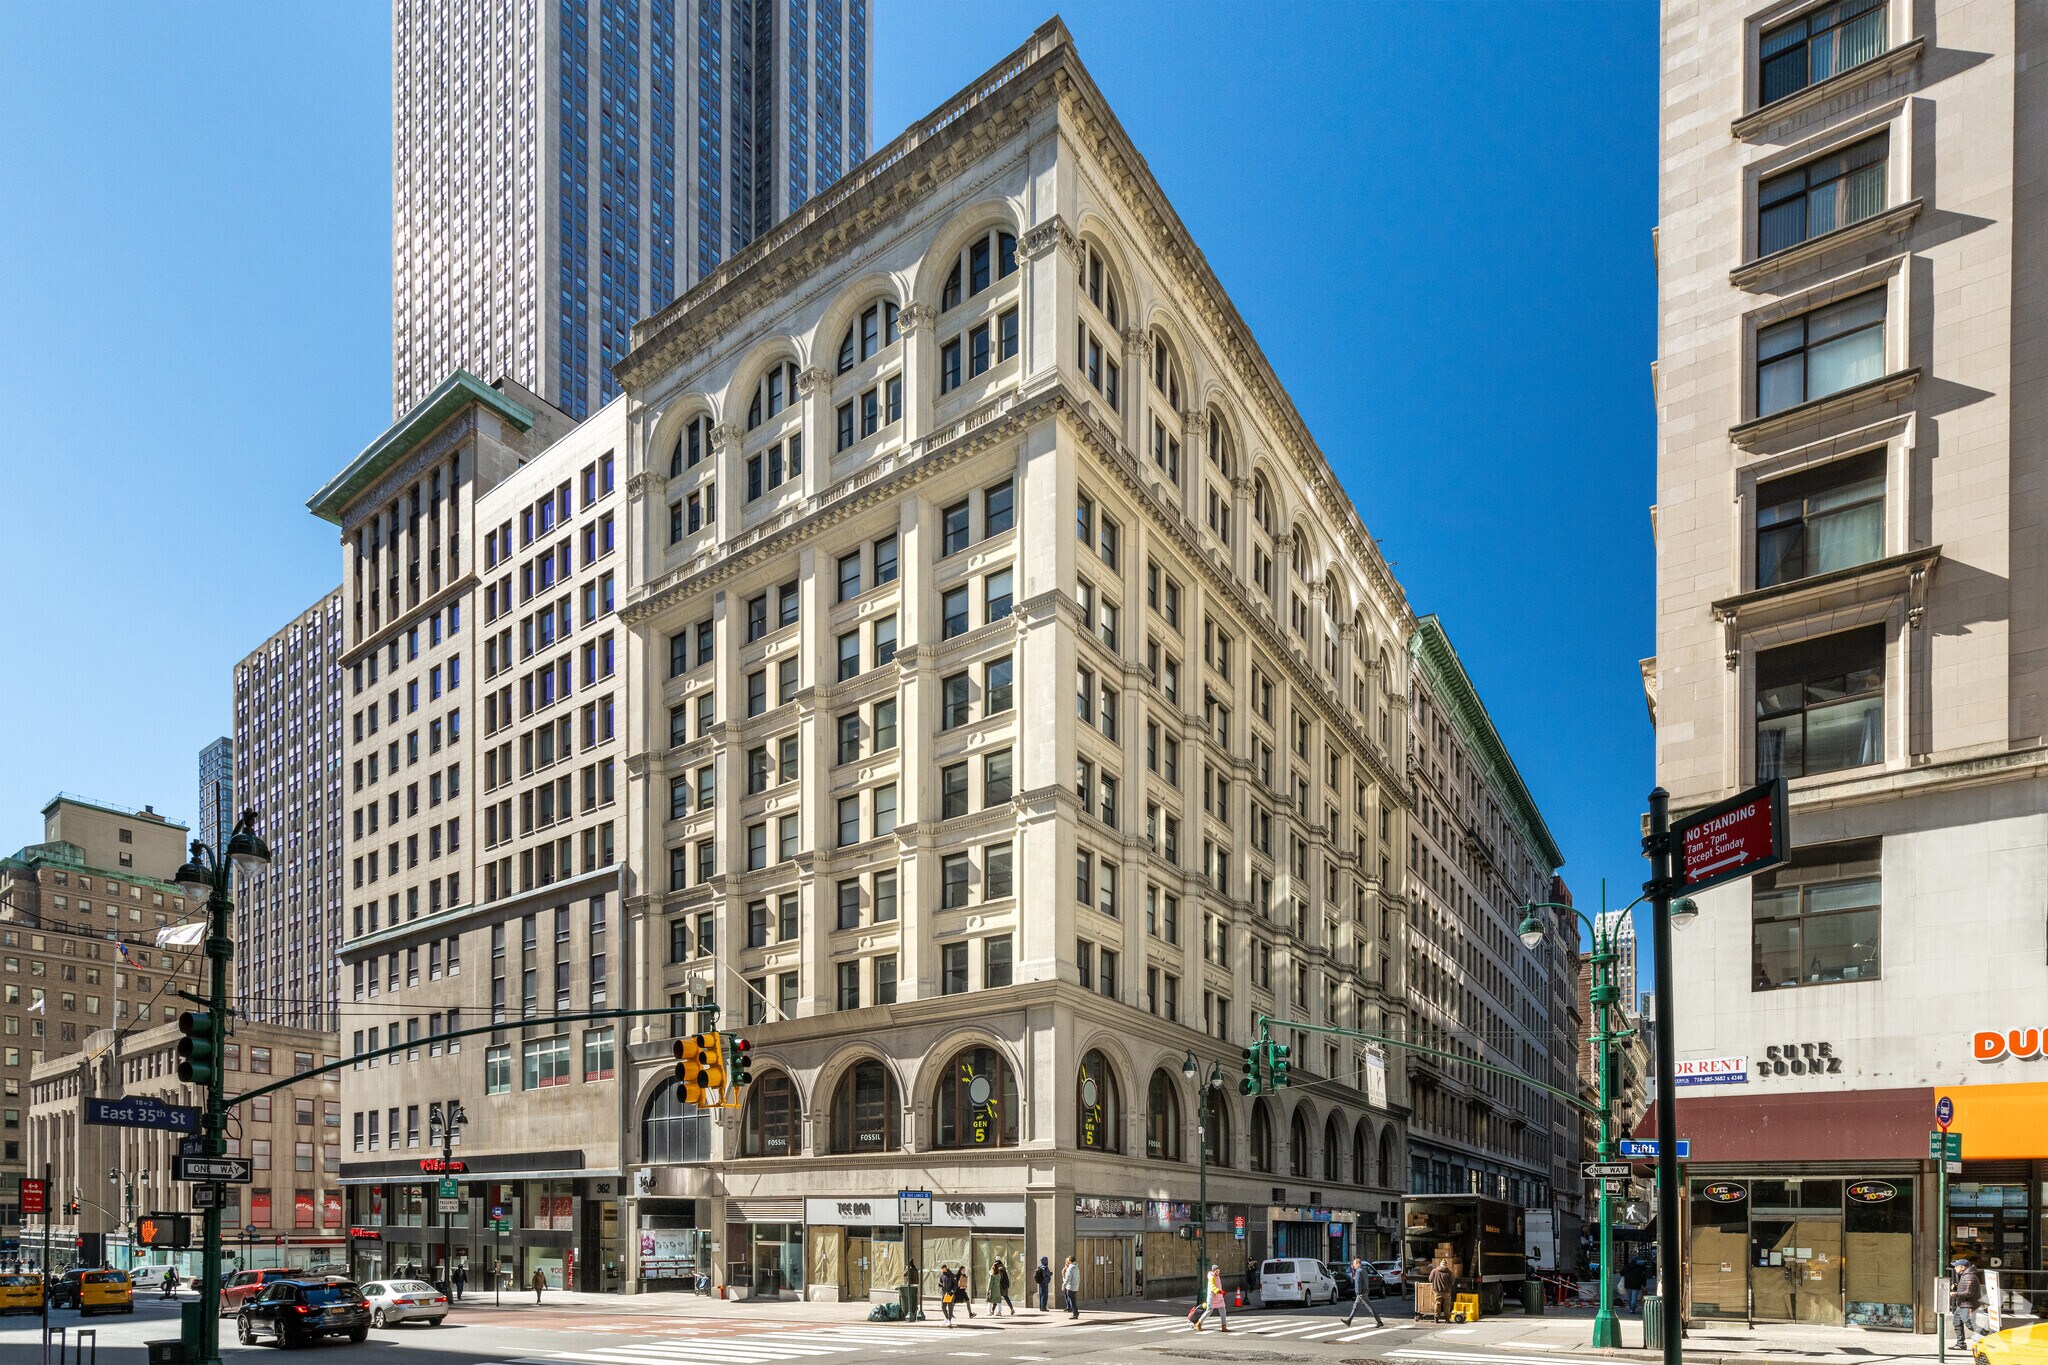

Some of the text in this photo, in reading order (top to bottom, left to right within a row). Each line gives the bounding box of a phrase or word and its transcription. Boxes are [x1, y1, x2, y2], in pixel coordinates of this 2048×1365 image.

[1686, 805, 1756, 842] NO STANDING
[1687, 841, 1703, 854] 7am
[1710, 832, 1727, 846] 7pm
[1687, 838, 1745, 866] Except Sunday
[1973, 1027, 2048, 1060] DU
[1766, 1042, 1832, 1061] CUTE
[1675, 1059, 1743, 1074] OR RENT
[1756, 1058, 1842, 1077] TOONZ
[100, 1106, 186, 1124] East 35th St
[1085, 1123, 1095, 1131] GEN
[976, 1129, 985, 1142] 5
[1086, 1132, 1093, 1145] 5
[1148, 1140, 1161, 1148] FOSSIL
[1631, 1143, 1655, 1154] Fifth
[193, 1164, 240, 1174] ONE WAY
[425, 1159, 464, 1172] CVS phmacy
[596, 1184, 610, 1194] 362
[1707, 1186, 1728, 1194] CUTE
[837, 1202, 871, 1216] TEE BAR
[945, 1202, 986, 1217] TEE BAR
